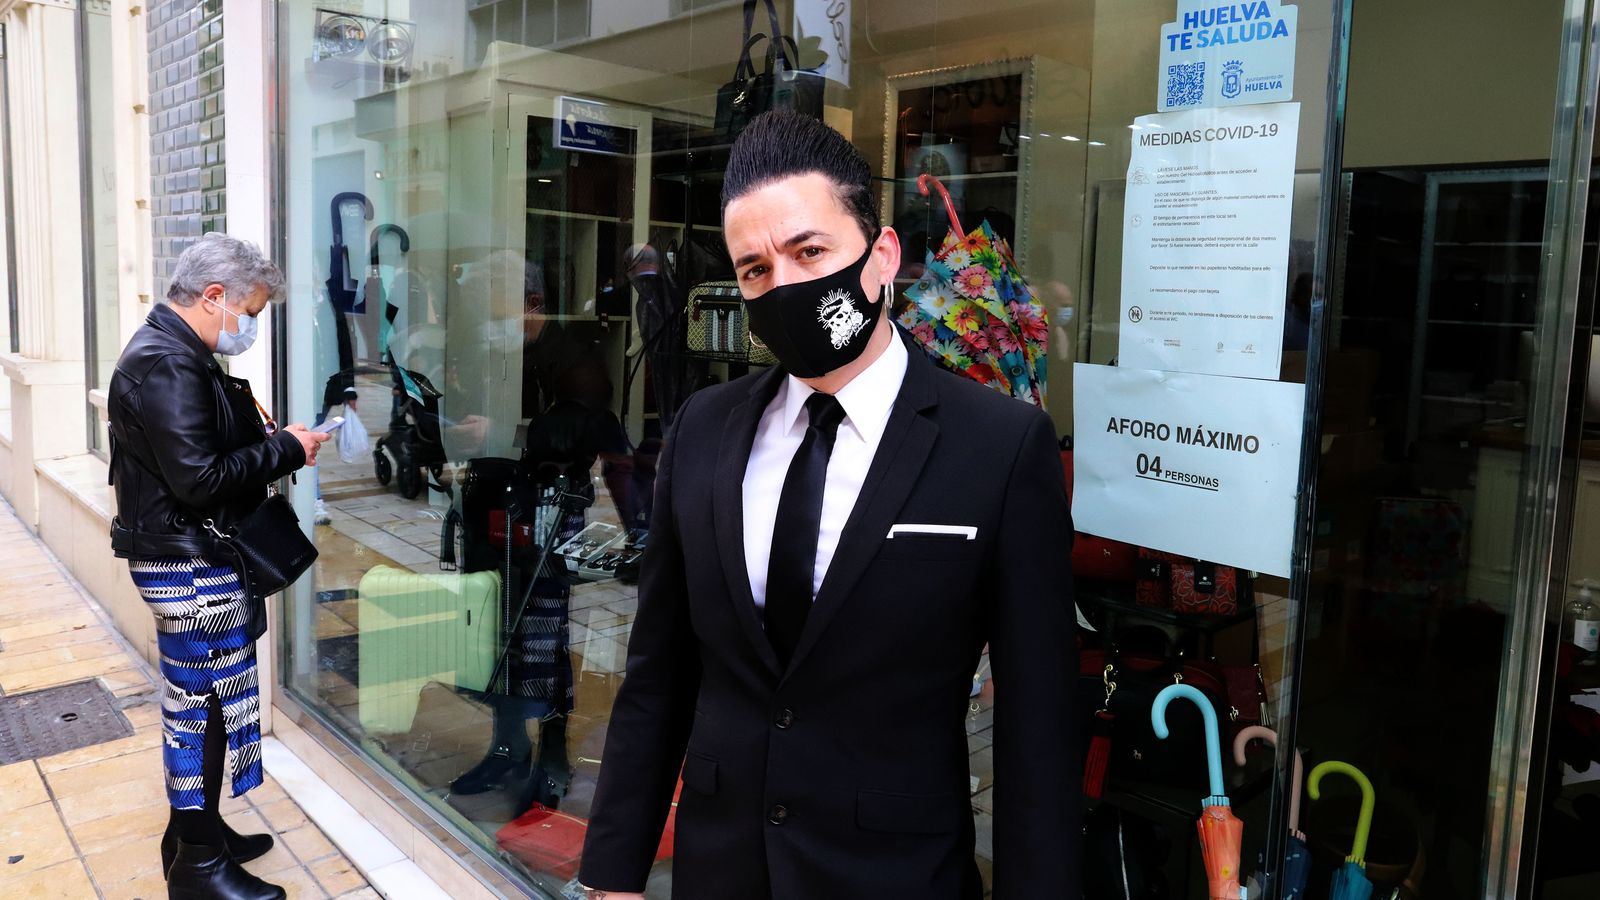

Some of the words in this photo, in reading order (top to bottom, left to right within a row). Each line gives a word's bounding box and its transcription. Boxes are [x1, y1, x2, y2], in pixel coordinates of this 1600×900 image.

[1184, 1, 1270, 30] HUELVA
[1167, 32, 1193, 51] TE
[1196, 19, 1288, 48] SALUDA
[1245, 81, 1282, 92] HUELVA
[1140, 130, 1202, 147] MEDIDAS
[1204, 123, 1278, 142] COVID-19
[1106, 417, 1170, 441] AFORO
[1176, 425, 1259, 454] MÁXIMO
[1136, 453, 1162, 478] 04
[1165, 470, 1219, 488] PERSONAS
